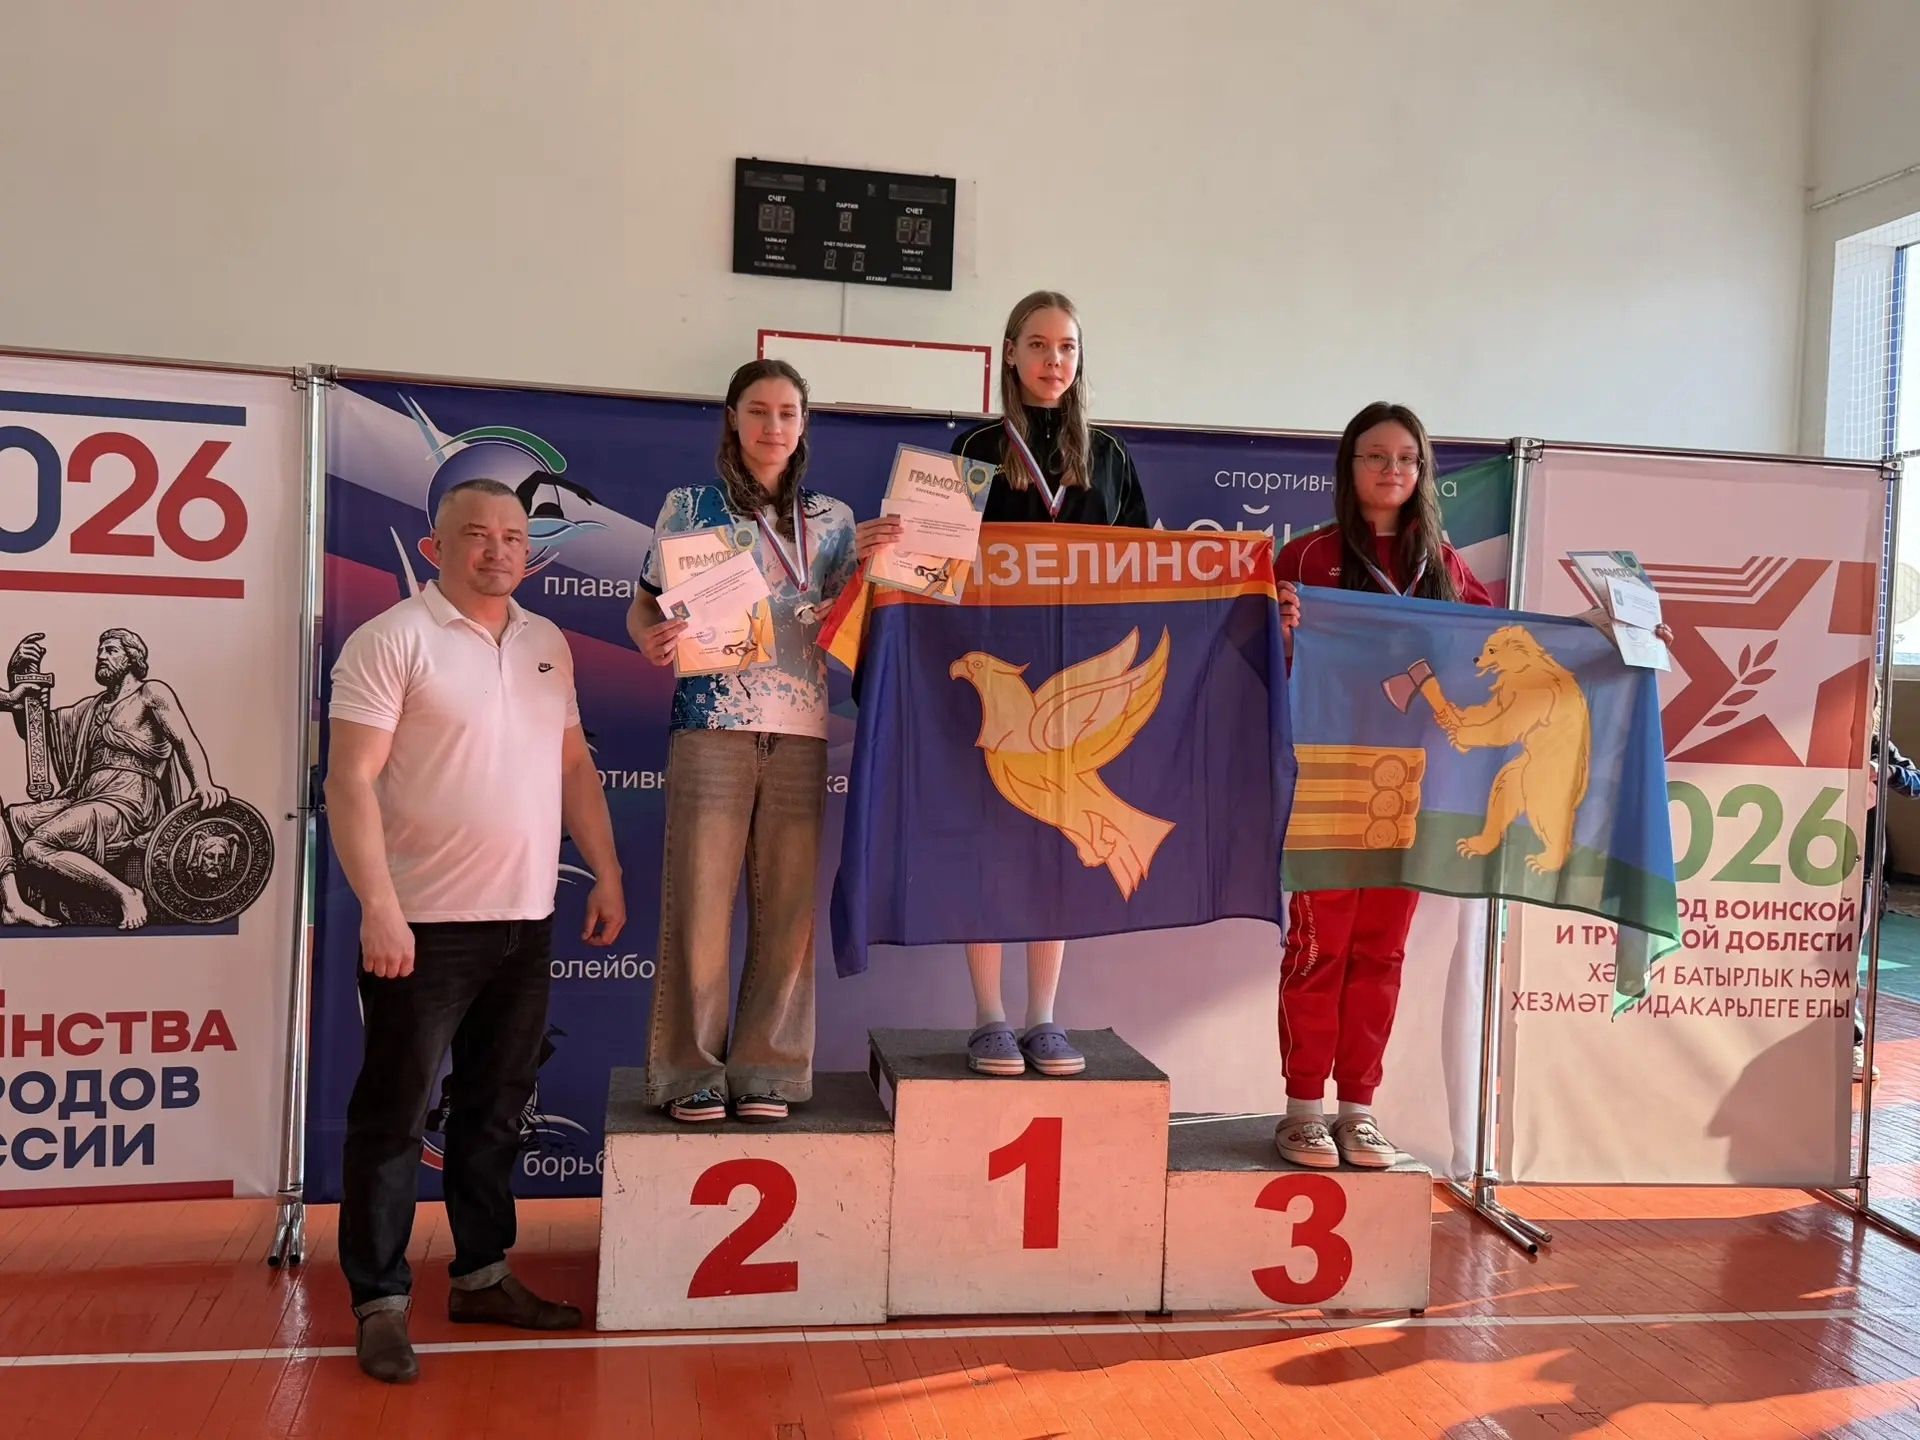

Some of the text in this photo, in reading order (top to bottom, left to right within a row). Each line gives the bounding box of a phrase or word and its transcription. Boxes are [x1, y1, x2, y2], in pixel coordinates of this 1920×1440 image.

[767, 194, 788, 204] СЧЕТ
[836, 202, 859, 210] ПАРТИЯ
[905, 207, 924, 216] СЧЕТ
[0, 425, 248, 562] 026
[907, 468, 968, 497] ГРАМОТА
[1215, 470, 1334, 494] спортивн
[1667, 780, 1858, 887] 026
[1676, 897, 1856, 922] ОД ВОИНСКОЙ
[1556, 925, 1574, 944] И
[1725, 930, 1853, 953] ДОБЛЕСТИ
[550, 953, 656, 979] олейбо
[1674, 965, 1795, 988] БАТЫРЛЫК
[1510, 991, 1850, 1019] ХЕЗМӘТ ИДАКАРЬЛЕГЕ ЕЛЫ
[0, 1009, 238, 1058] НСТВА
[0, 1066, 200, 1120] ОДОВ
[523, 1150, 604, 1182] борьб
[987, 1116, 1063, 1250] 1
[687, 1158, 799, 1299] 2
[1251, 1173, 1354, 1306] 3
